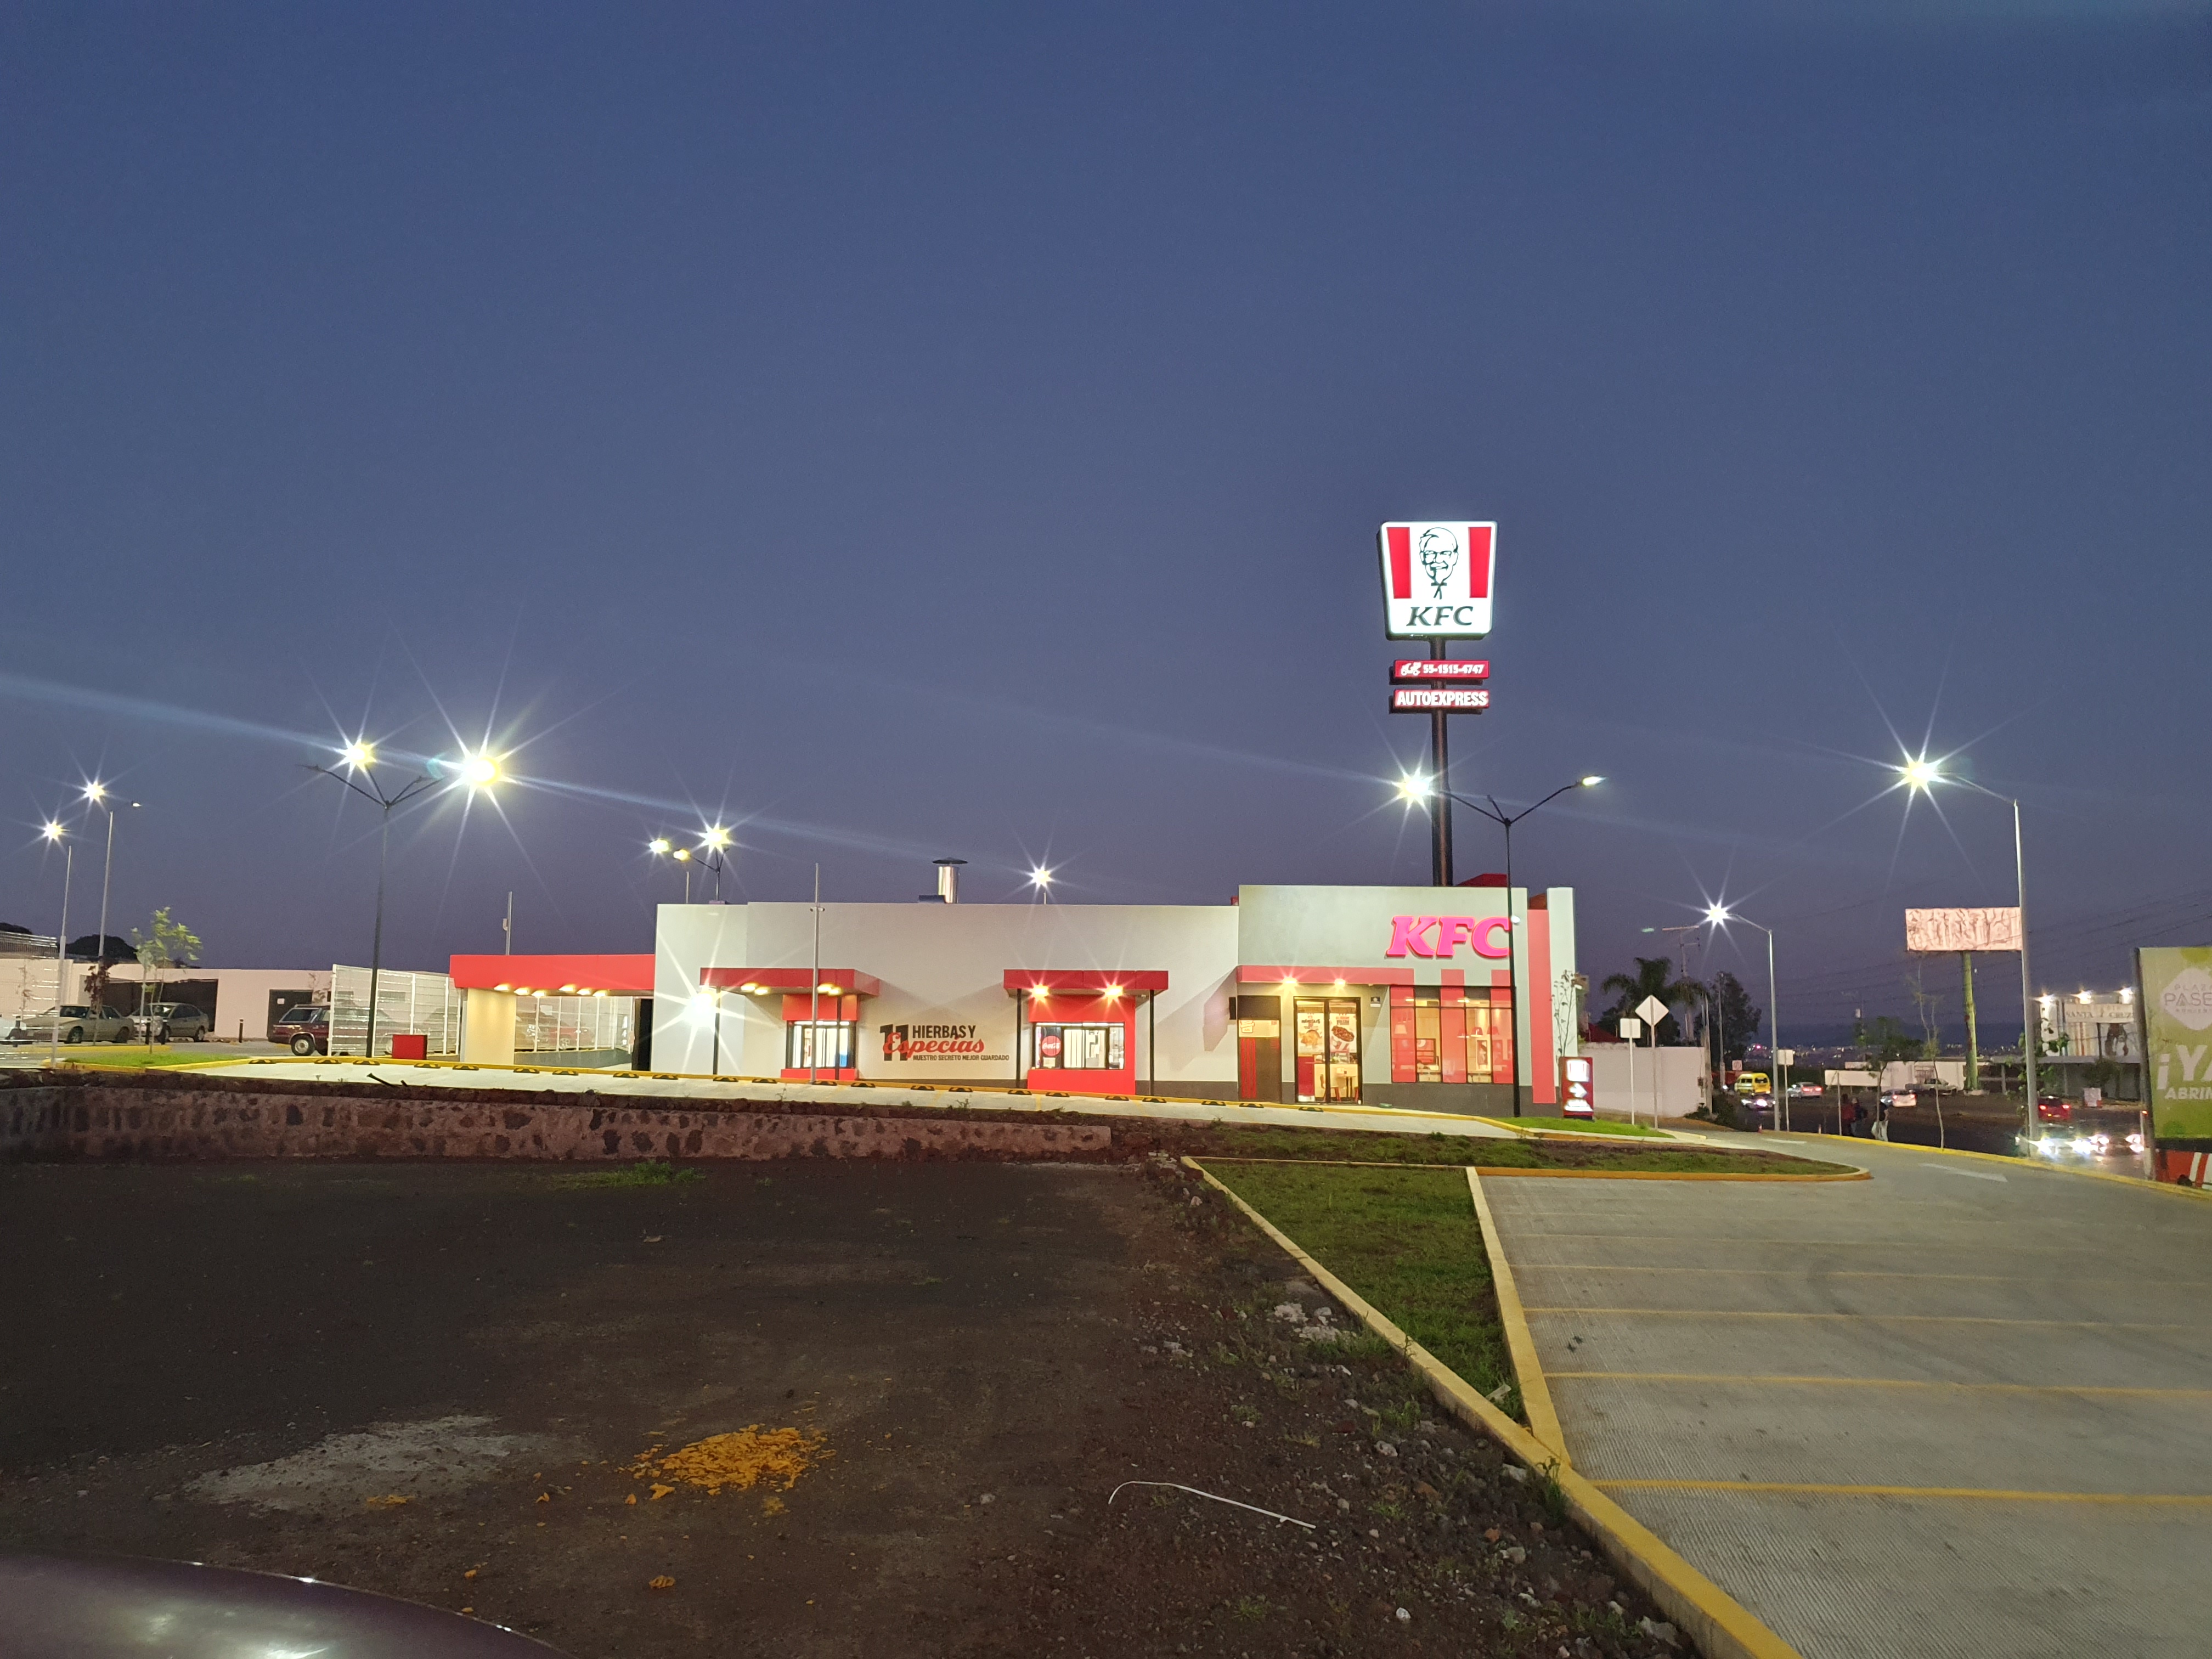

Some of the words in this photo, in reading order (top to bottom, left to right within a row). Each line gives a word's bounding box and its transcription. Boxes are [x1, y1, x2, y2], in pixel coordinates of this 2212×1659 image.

[1406, 606, 1474, 626] KFC
[1423, 664, 1484, 674] 55-1515-4747
[1397, 691, 1488, 706] AUTOEXPRESS
[1386, 916, 1510, 957] KFC
[912, 1025, 966, 1039] HIERBAS
[968, 1025, 976, 1038] Y
[880, 1024, 909, 1061] 11
